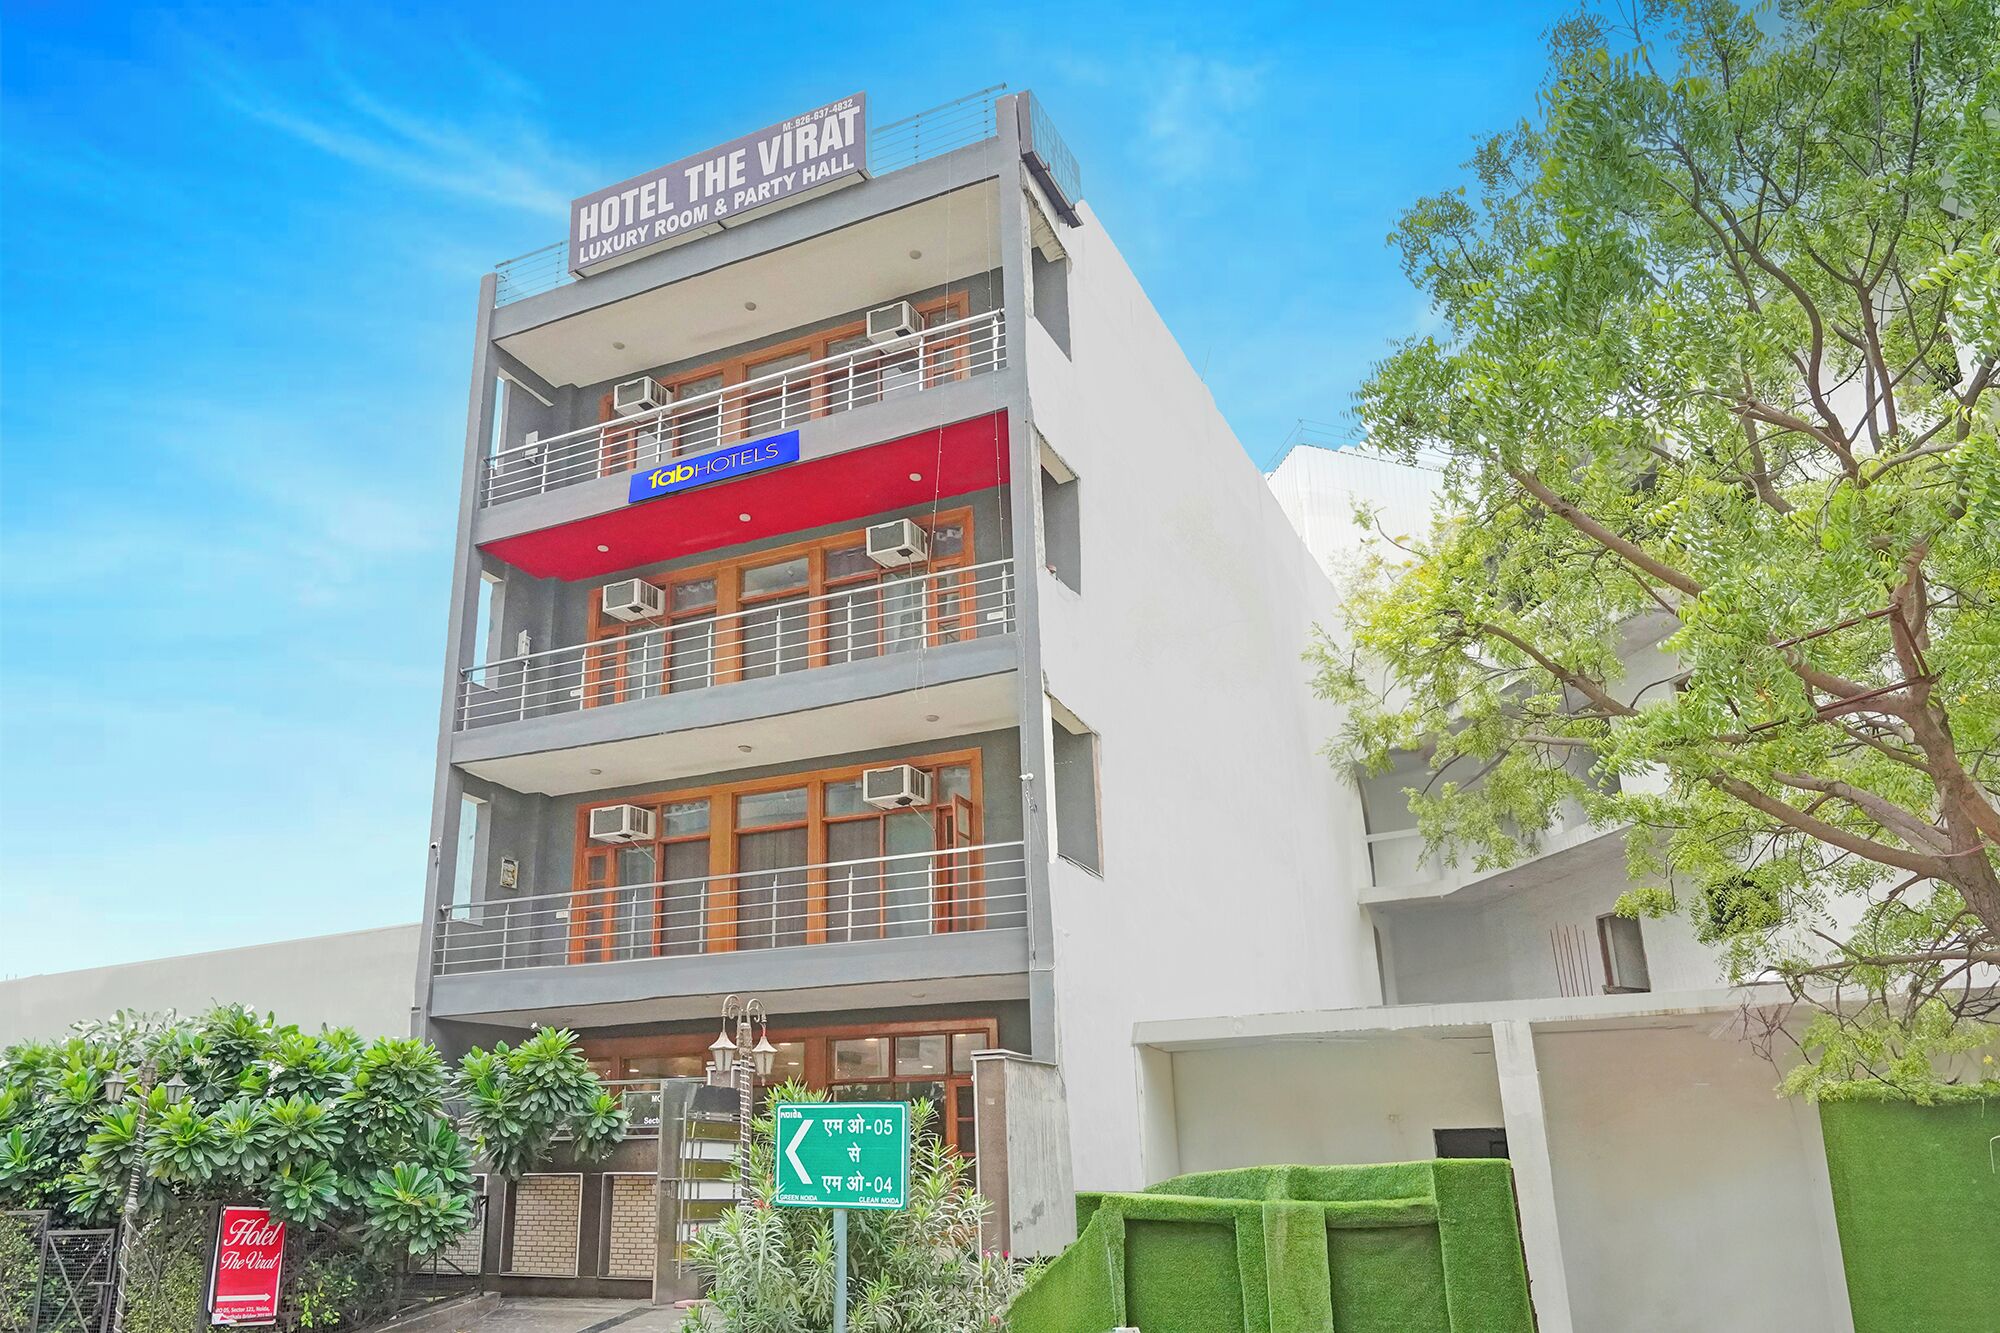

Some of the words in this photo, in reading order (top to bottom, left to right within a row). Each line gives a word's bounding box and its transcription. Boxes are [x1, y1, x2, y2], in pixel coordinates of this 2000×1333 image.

[579, 178, 674, 242] HOTEL
[685, 148, 746, 202] THE
[757, 106, 860, 175] VIRAT
[579, 224, 649, 263] LUXURY
[654, 204, 708, 238] ROOM
[714, 198, 727, 216] &
[734, 171, 796, 209] PARTY
[802, 152, 854, 185] HALL
[644, 1117, 660, 1125] Sect
[822, 1119, 844, 1137] एम
[847, 1142, 861, 1163] से
[821, 1175, 843, 1194] एम
[223, 1218, 283, 1246] Hotel
[221, 1251, 245, 1270] The
